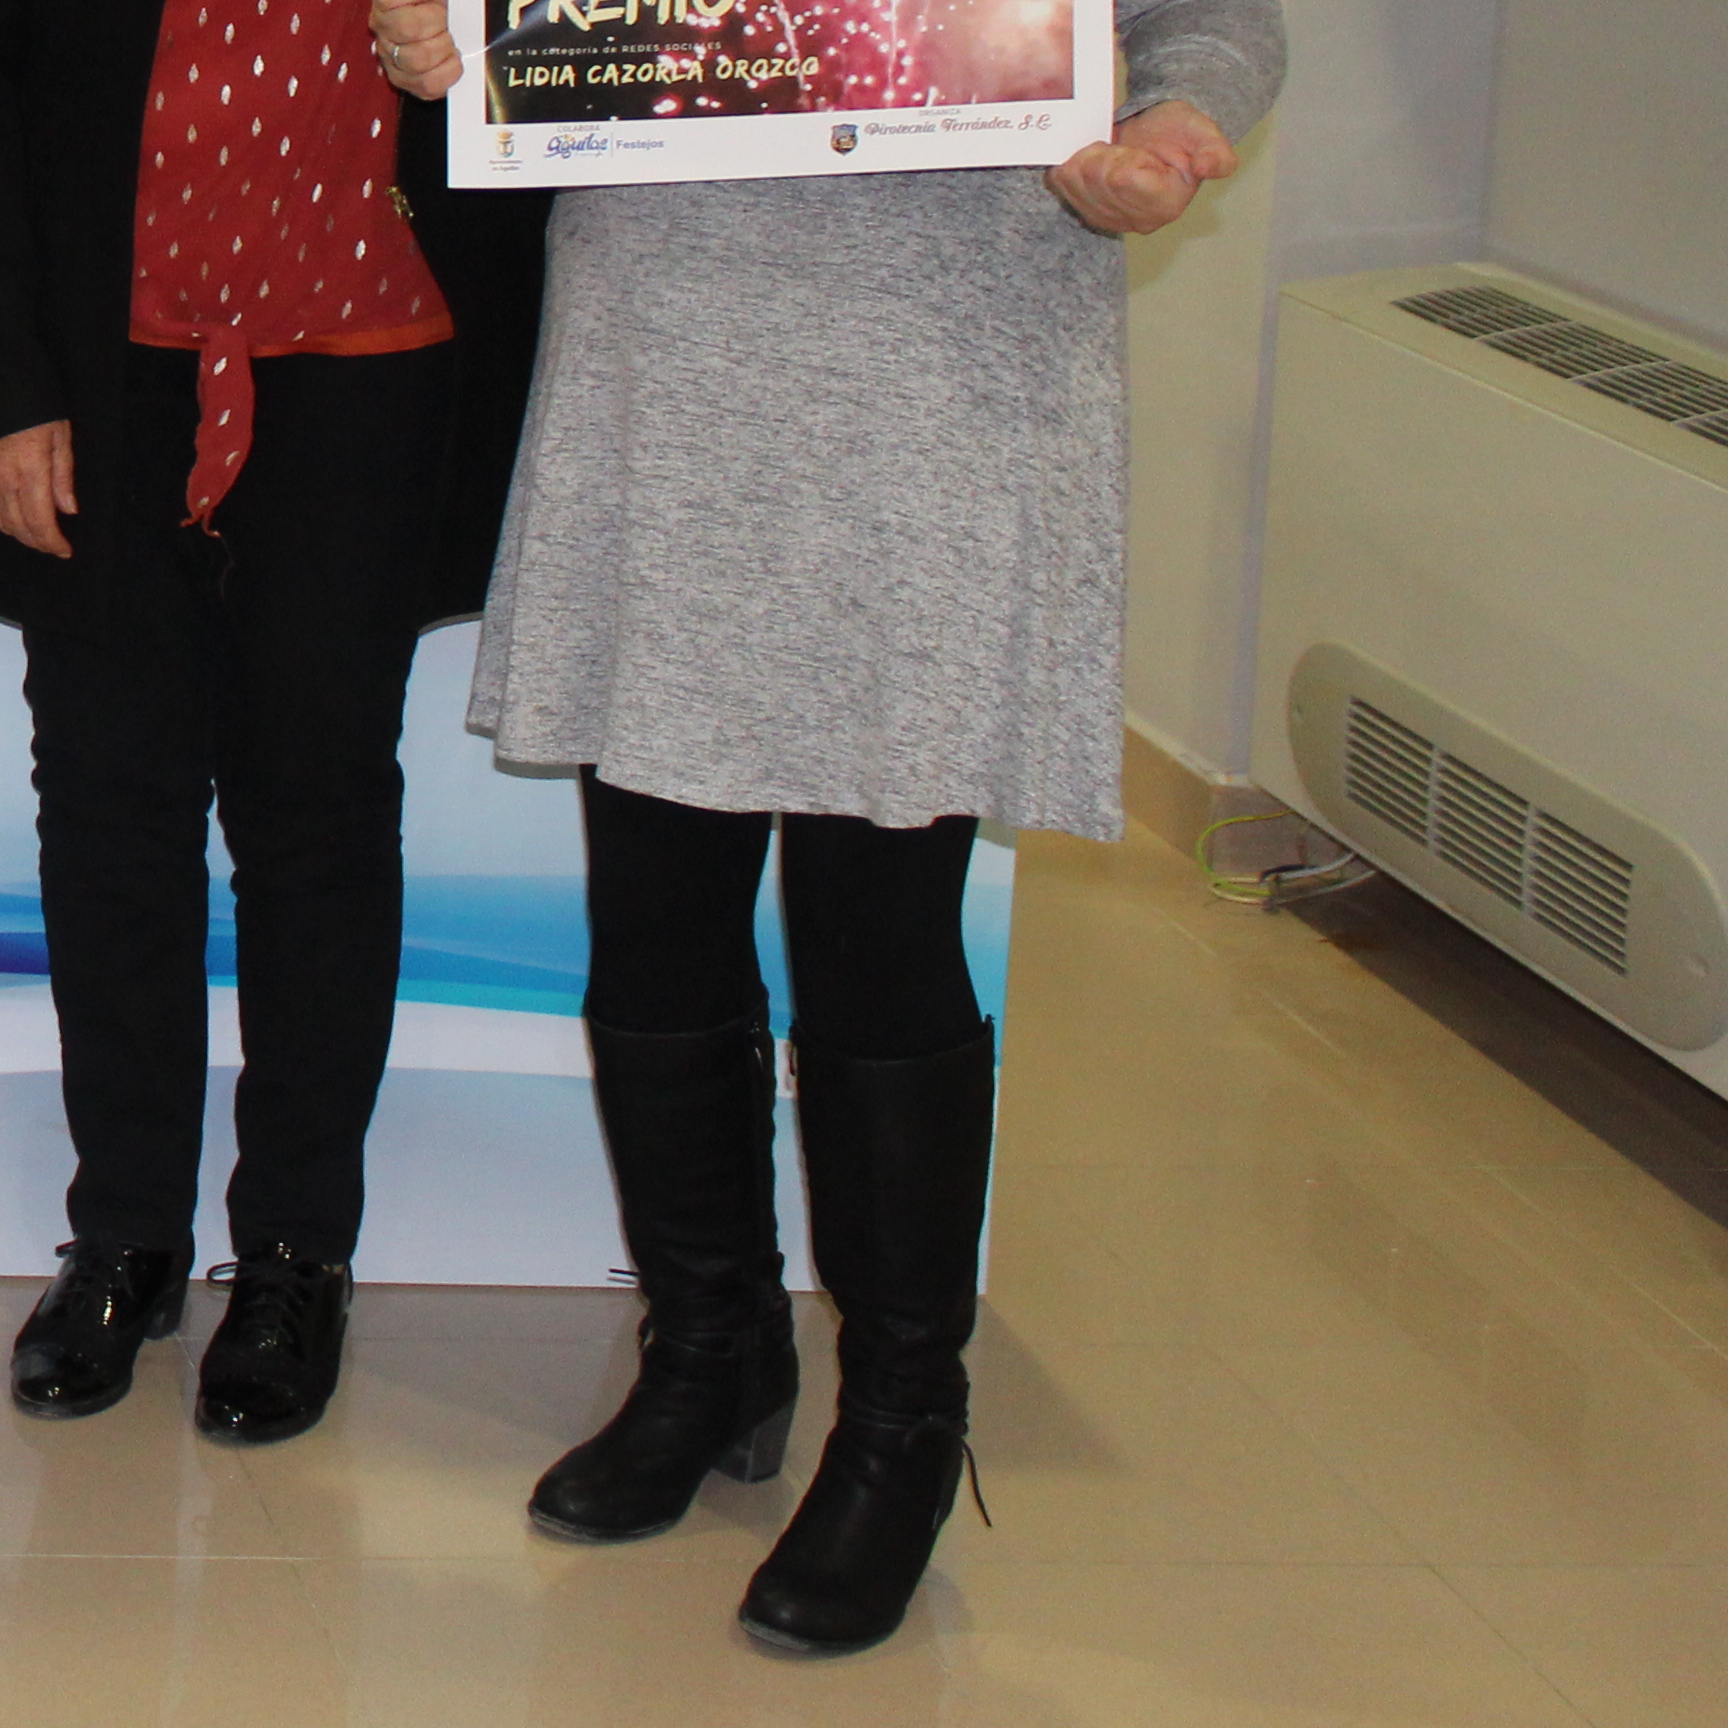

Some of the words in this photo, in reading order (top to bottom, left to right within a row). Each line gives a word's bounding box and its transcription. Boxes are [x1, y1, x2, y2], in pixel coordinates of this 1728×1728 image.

[507, 48, 522, 57] en
[526, 47, 538, 56] la
[602, 45, 617, 54] de
[621, 43, 660, 54] REDES
[508, 65, 576, 88] LIDIA
[586, 60, 704, 86] CAZORLA
[716, 56, 821, 81] OROZCO
[616, 139, 665, 151] Festejos
